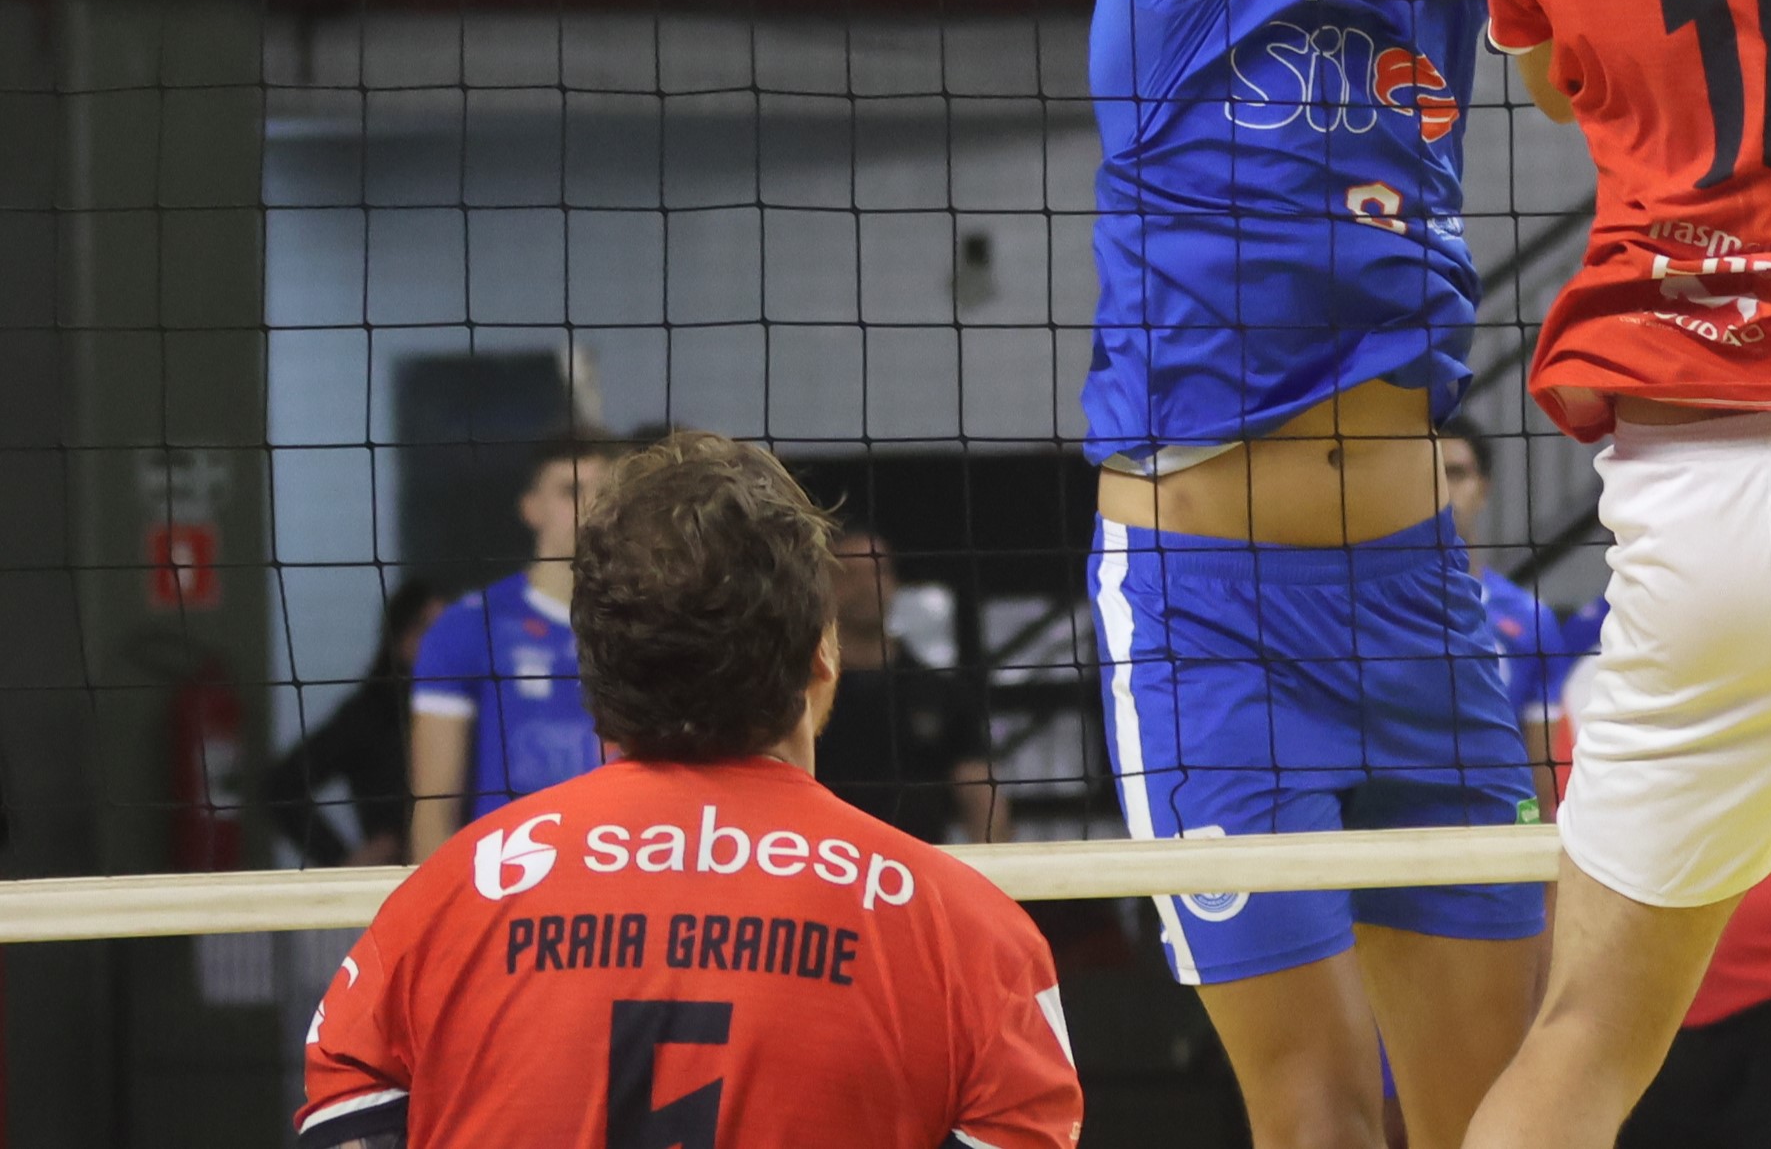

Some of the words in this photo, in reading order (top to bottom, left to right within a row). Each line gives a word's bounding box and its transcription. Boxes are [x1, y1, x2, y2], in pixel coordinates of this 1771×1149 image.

[583, 805, 915, 911] sabesp
[506, 913, 648, 975] PRAIA
[665, 913, 860, 986] GRANDE
